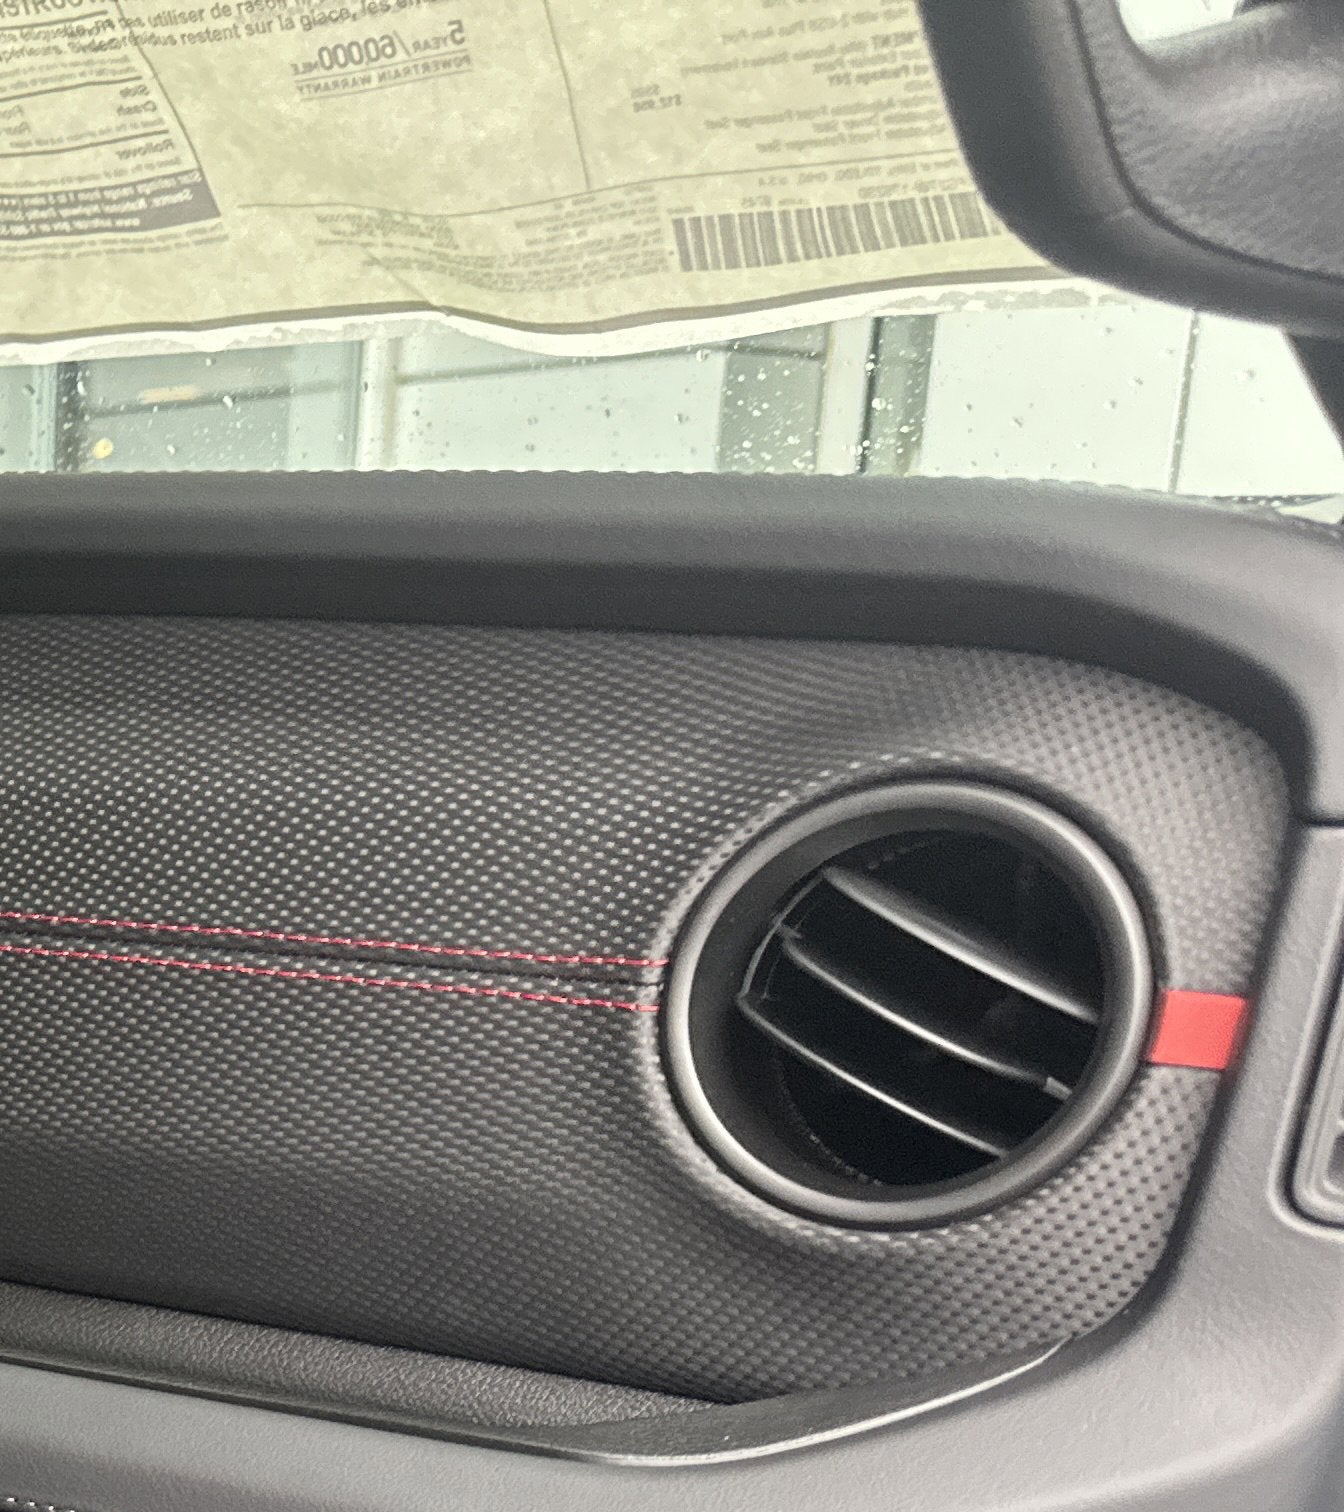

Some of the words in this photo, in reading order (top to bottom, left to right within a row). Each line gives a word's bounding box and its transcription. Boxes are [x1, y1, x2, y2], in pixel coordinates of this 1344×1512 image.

[147, 8, 206, 28] utiliser
[210, 2, 233, 20] de
[181, 24, 241, 45] restent
[244, 18, 273, 36] sur
[275, 14, 296, 31] la
[299, 8, 356, 32] glace,
